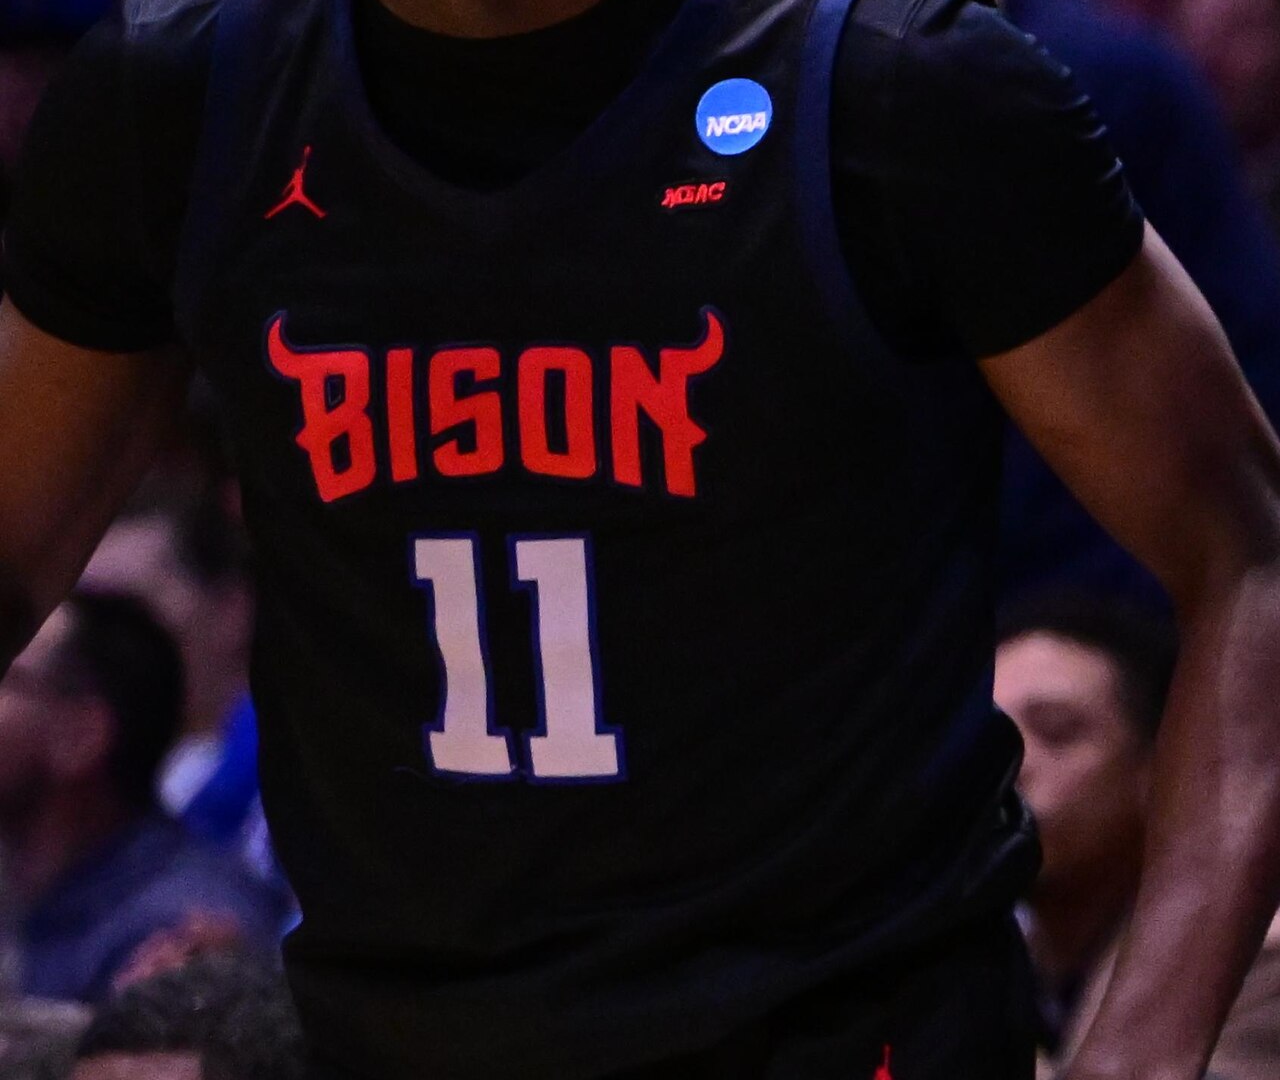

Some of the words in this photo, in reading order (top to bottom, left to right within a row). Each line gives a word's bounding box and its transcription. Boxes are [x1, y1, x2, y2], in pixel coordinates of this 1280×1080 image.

[705, 111, 767, 137] NCAA
[264, 308, 726, 504] BISON
[407, 531, 627, 785] 11
